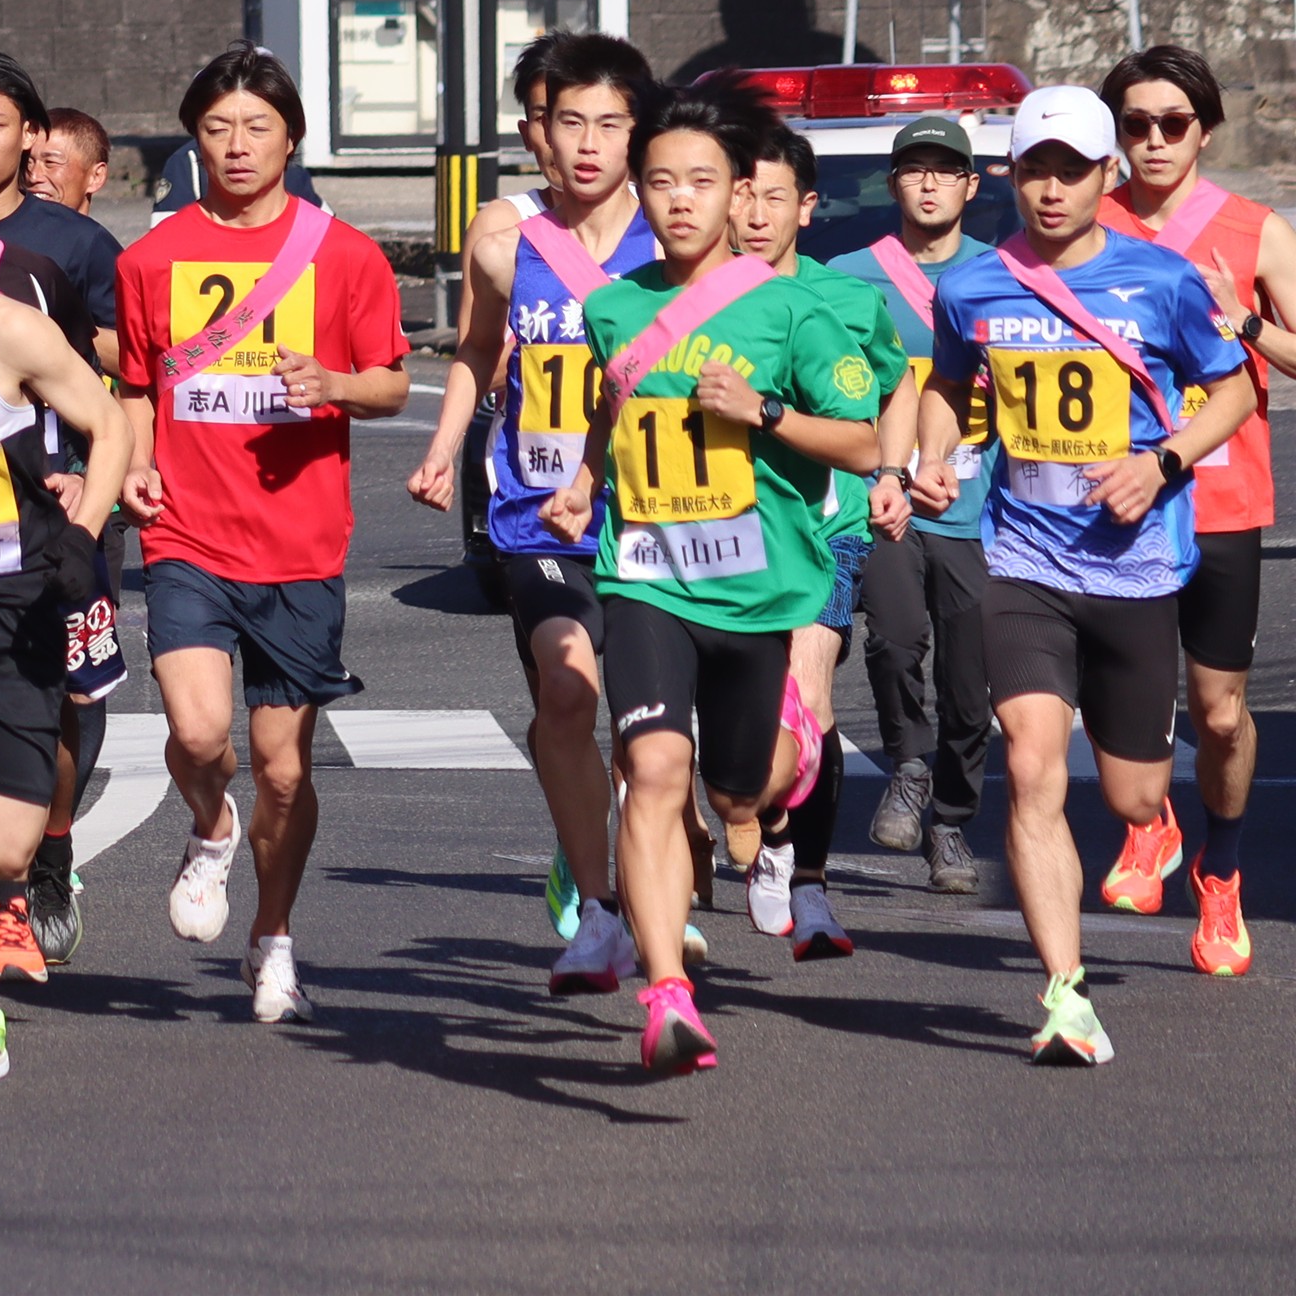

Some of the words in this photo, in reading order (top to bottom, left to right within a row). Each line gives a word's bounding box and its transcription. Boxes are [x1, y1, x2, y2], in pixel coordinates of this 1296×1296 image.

[973, 317, 1145, 344] BEPPU-TA
[188, 388, 230, 413] 志A
[242, 390, 290, 416] 川口
[1014, 360, 1094, 432] 18
[638, 411, 709, 489] 11
[1010, 434, 1108, 457] 波佐見一周駅伝大会
[682, 535, 741, 568] 山口
